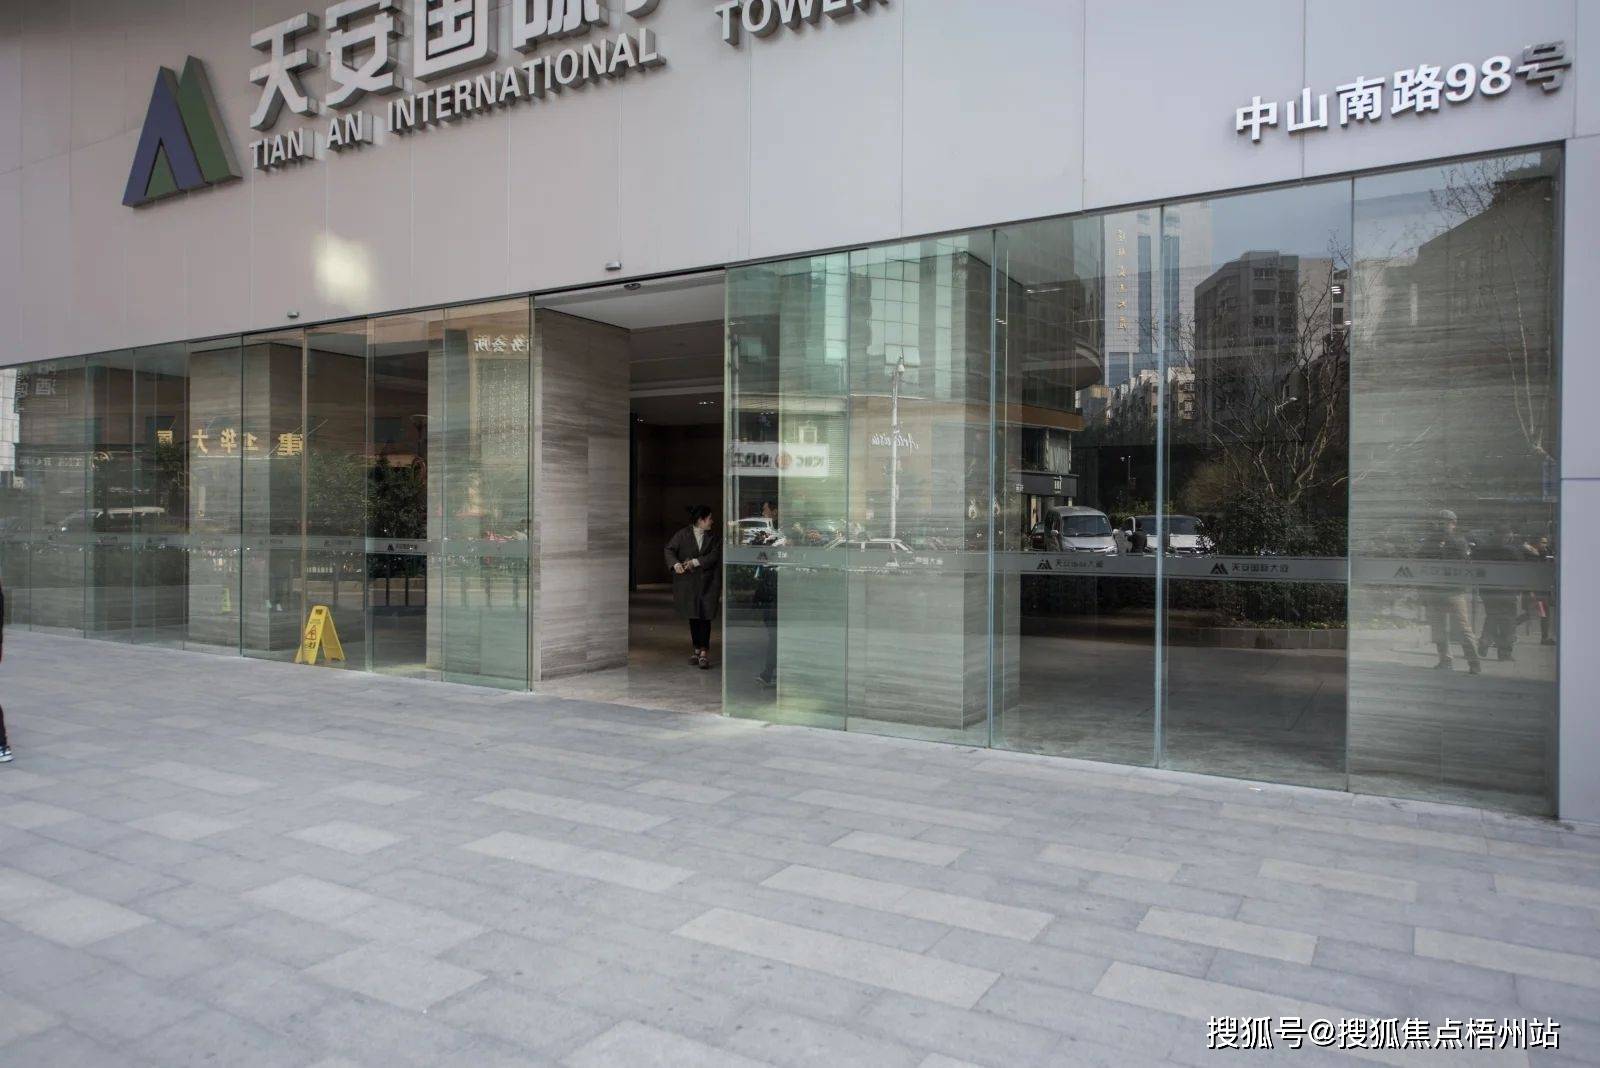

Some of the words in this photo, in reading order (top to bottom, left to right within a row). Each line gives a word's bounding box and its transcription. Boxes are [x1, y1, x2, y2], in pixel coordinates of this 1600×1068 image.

[250, 127, 305, 169] TIAN
[326, 110, 364, 149] AN
[388, 28, 658, 132] INTERNATIONAL
[714, 0, 888, 42] TOW
[1235, 41, 1572, 142] 中山南路98号
